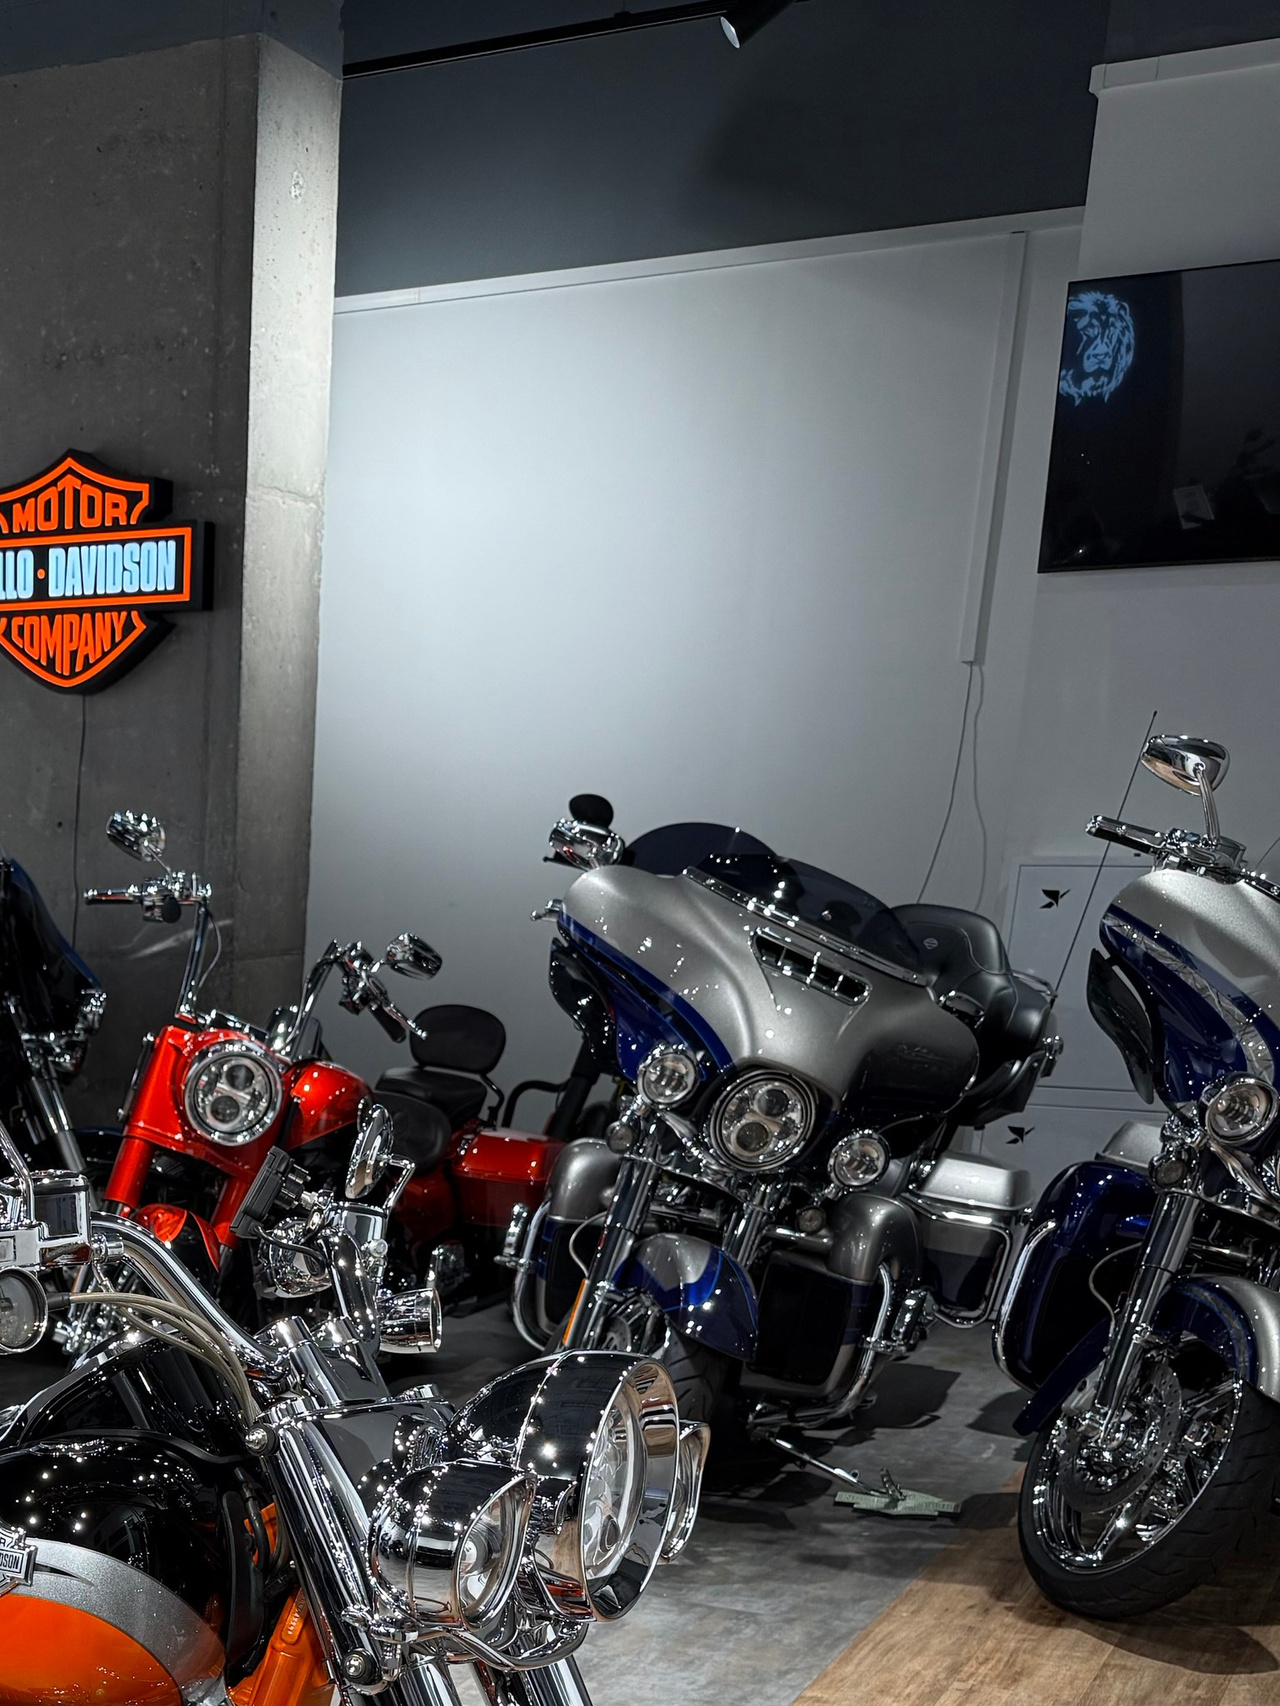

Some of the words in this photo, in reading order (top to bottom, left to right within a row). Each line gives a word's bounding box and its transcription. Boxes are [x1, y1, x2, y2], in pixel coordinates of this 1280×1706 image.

[12, 474, 128, 533] MOTOR
[48, 539, 176, 598] DAVIDSON
[11, 611, 128, 676] COMPANY
